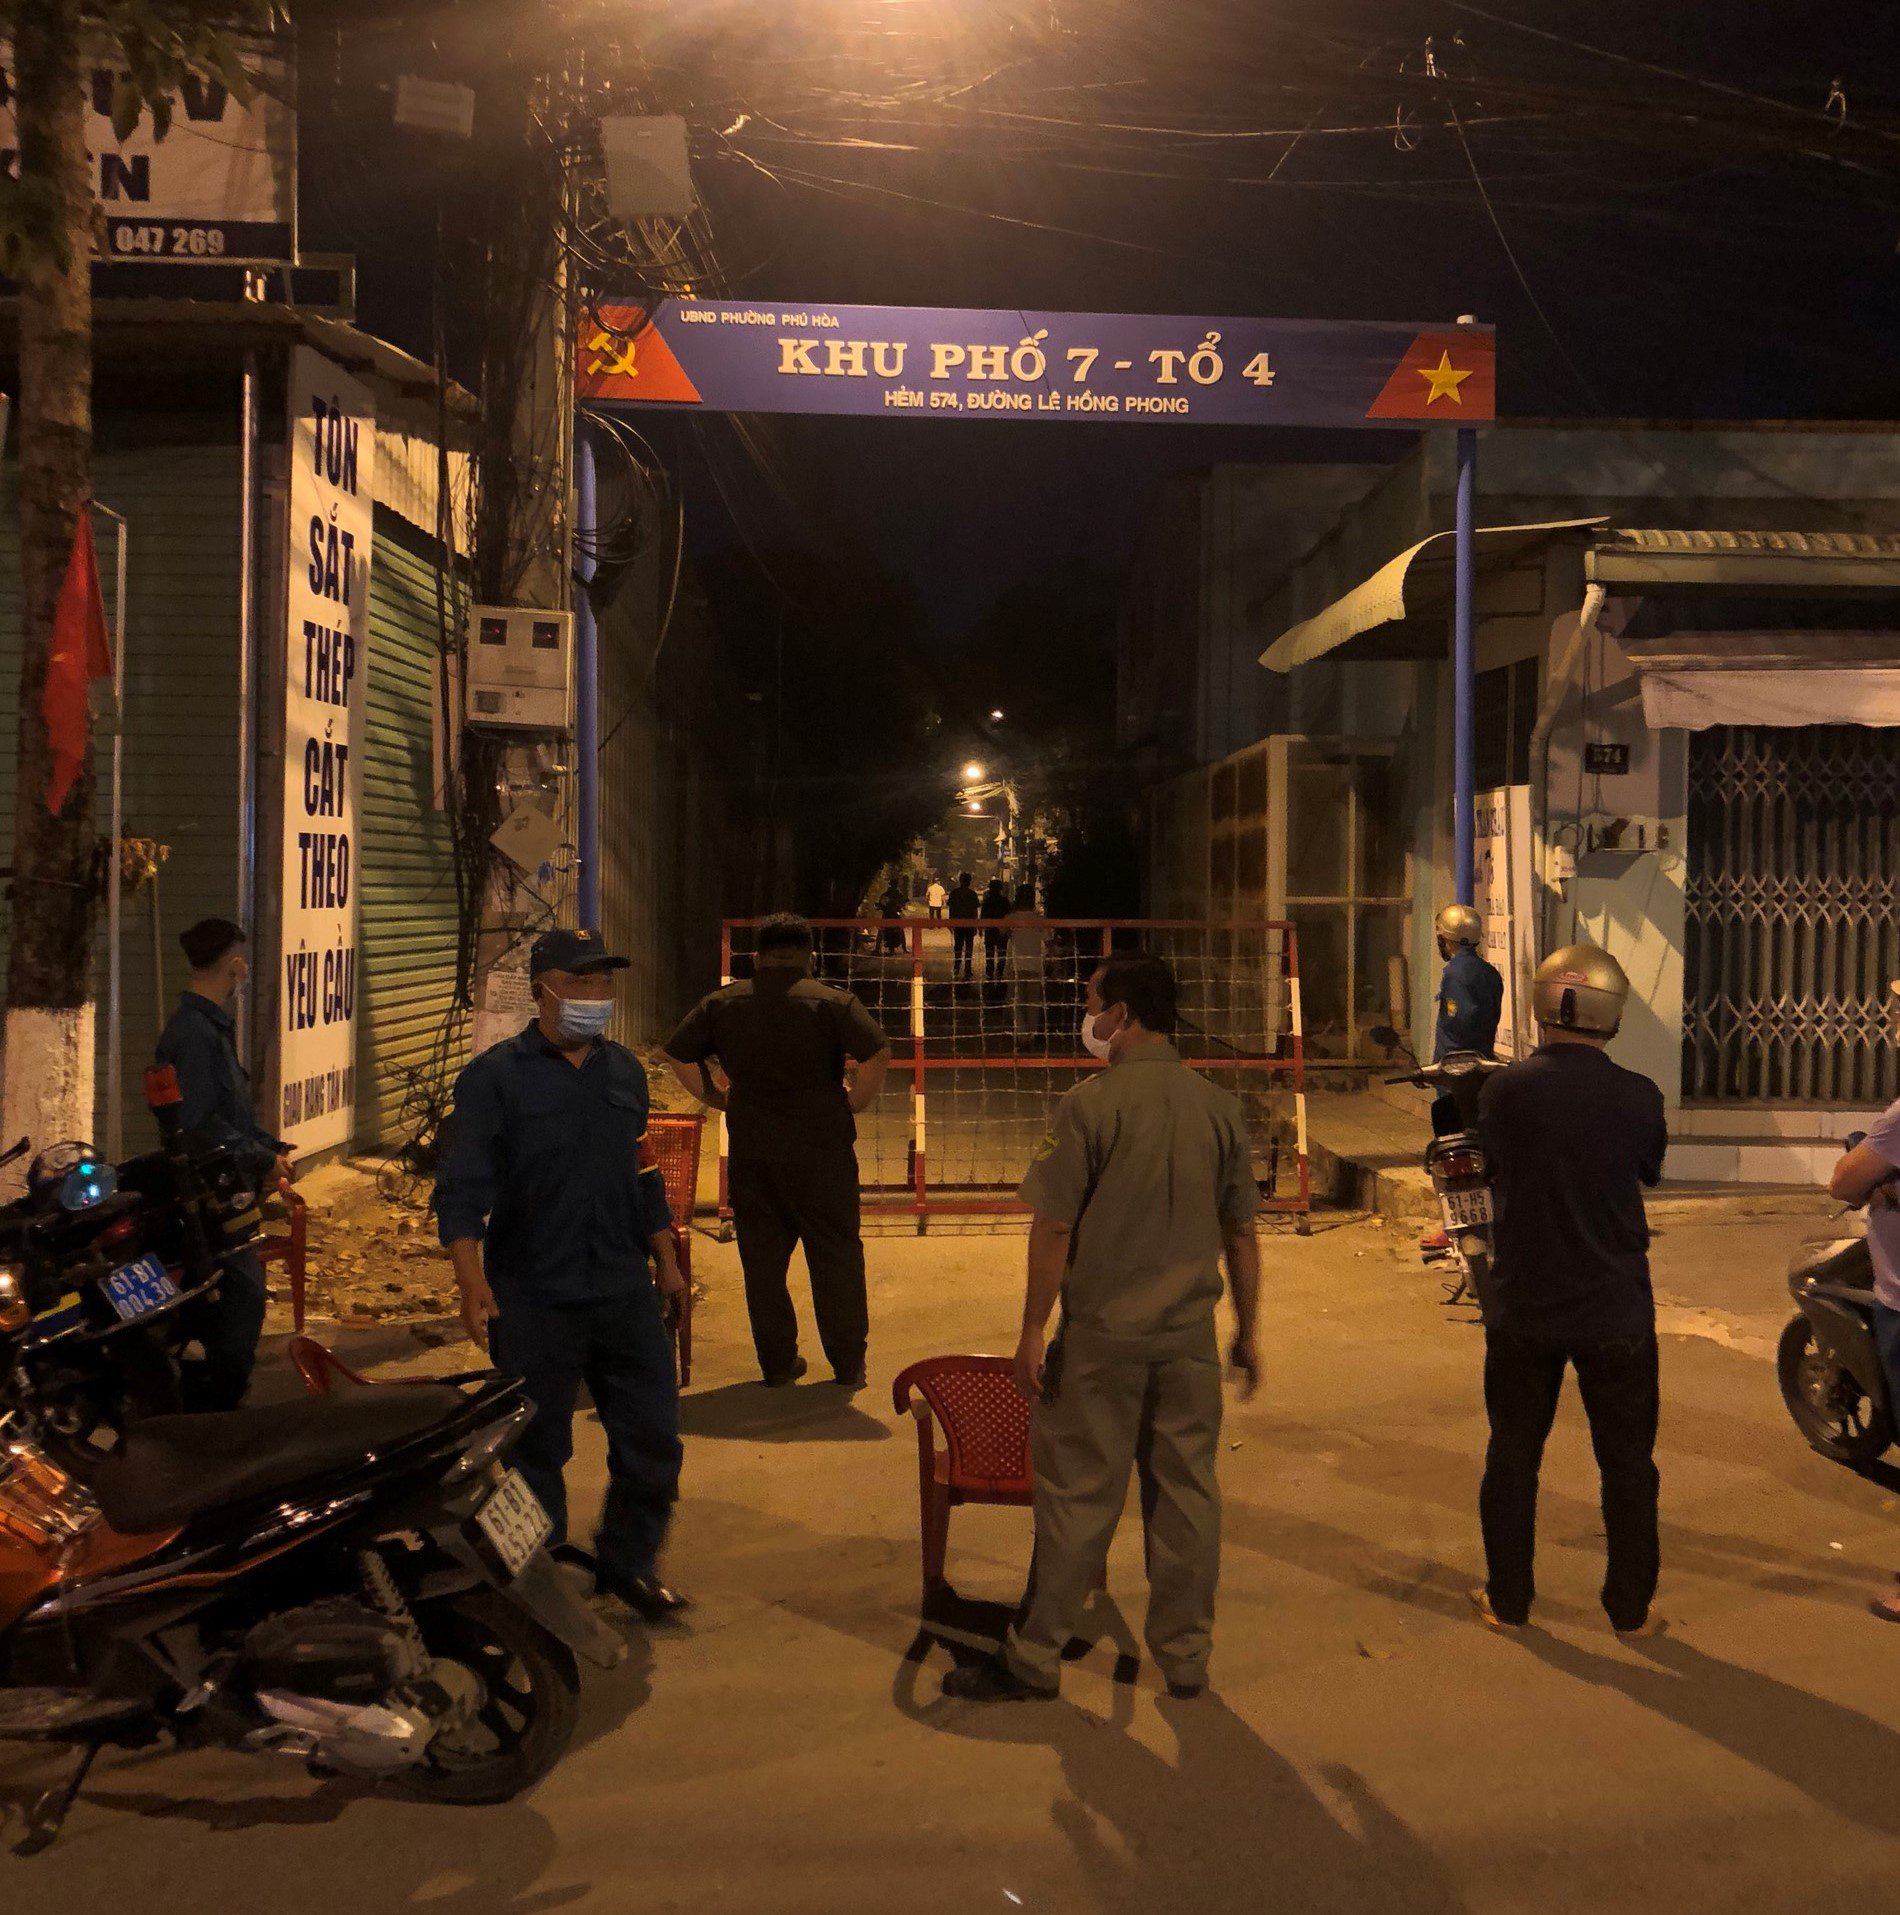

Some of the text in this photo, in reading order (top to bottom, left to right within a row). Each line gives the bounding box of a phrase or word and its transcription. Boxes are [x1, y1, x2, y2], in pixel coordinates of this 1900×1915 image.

[116, 226, 225, 255] 047 269
[680, 310, 717, 324] UBND
[812, 313, 840, 328] HÒA
[777, 338, 908, 378] KHU
[929, 328, 1049, 382] PHỐ
[1066, 348, 1099, 383] 7
[1149, 331, 1225, 385] TỔ
[1242, 352, 1276, 387] 4
[929, 391, 963, 412] 574,
[966, 389, 1033, 411] ĐƯỜNG
[1038, 390, 1061, 411] LÊ
[1066, 389, 1120, 412] HỒNG
[1125, 396, 1190, 413] PHONG
[312, 395, 359, 497] TÔN
[308, 502, 355, 607] SẮT
[303, 618, 356, 708] THÉP
[305, 718, 349, 818] CẮT
[299, 832, 350, 910] THEO
[286, 923, 356, 1032] YÊU CẦU
